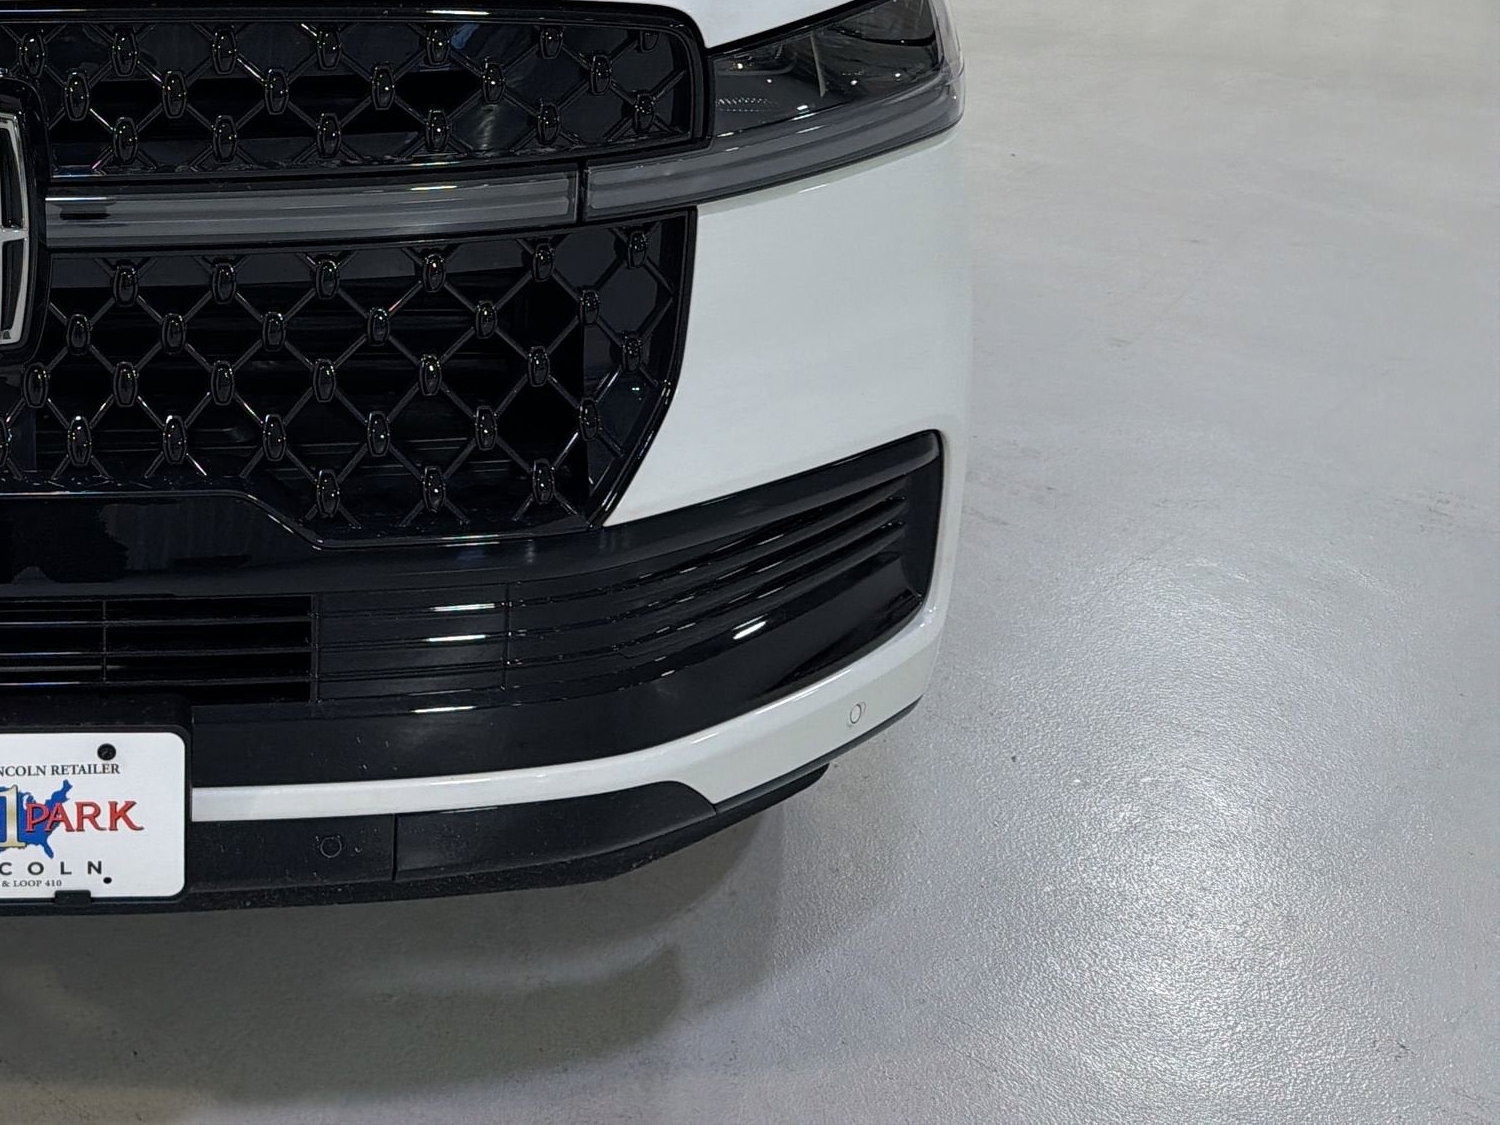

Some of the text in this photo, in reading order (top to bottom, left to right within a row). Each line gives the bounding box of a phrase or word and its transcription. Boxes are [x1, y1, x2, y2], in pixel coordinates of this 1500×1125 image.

[50, 763, 121, 775] RETAILER
[26, 800, 145, 833] PARK
[1, 880, 11, 888] &
[13, 880, 43, 888] LOOP
[44, 879, 63, 887] 410
